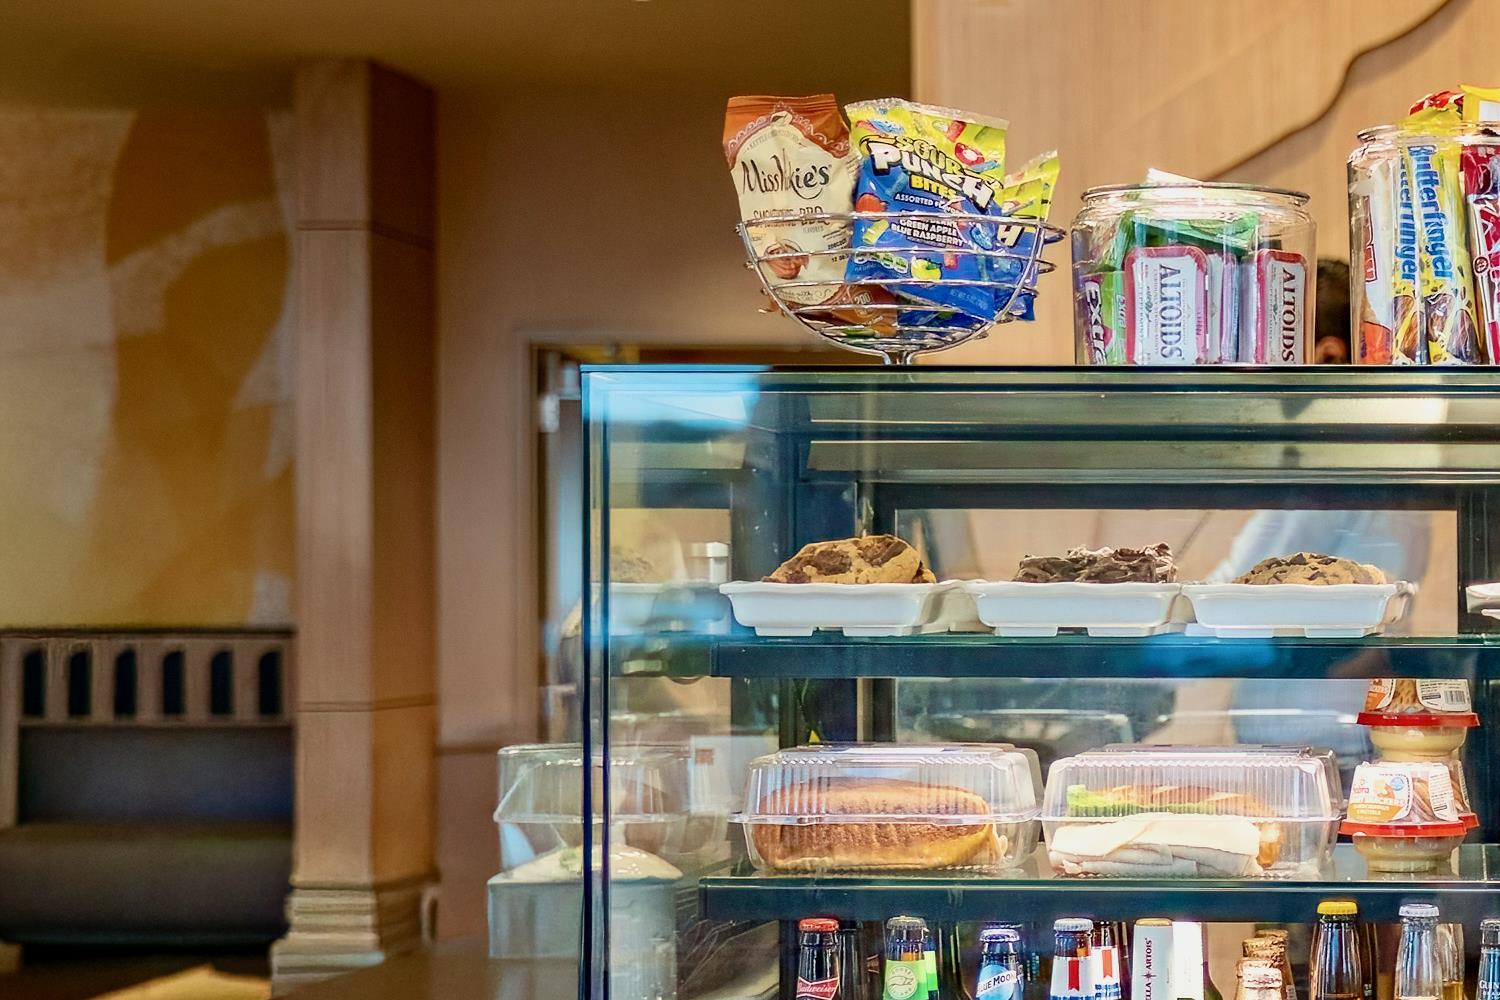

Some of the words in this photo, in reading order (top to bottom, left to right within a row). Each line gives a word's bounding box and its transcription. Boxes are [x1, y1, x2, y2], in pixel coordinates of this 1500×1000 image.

[896, 135, 963, 175] SOUR
[868, 141, 994, 209] PUNCH
[911, 175, 958, 197] BITES
[895, 193, 933, 207] ASSORTED
[1408, 144, 1453, 280] Butterfinger
[891, 224, 907, 236] BLUE
[907, 228, 965, 247] RASPBERRY
[900, 219, 930, 231] GREEN
[930, 226, 958, 238] APPLE
[1159, 263, 1182, 359] ALTOIDS
[1282, 267, 1296, 362] ALTOIDS
[1144, 938, 1152, 972] ARTOIS
[798, 982, 837, 993] Budweiser
